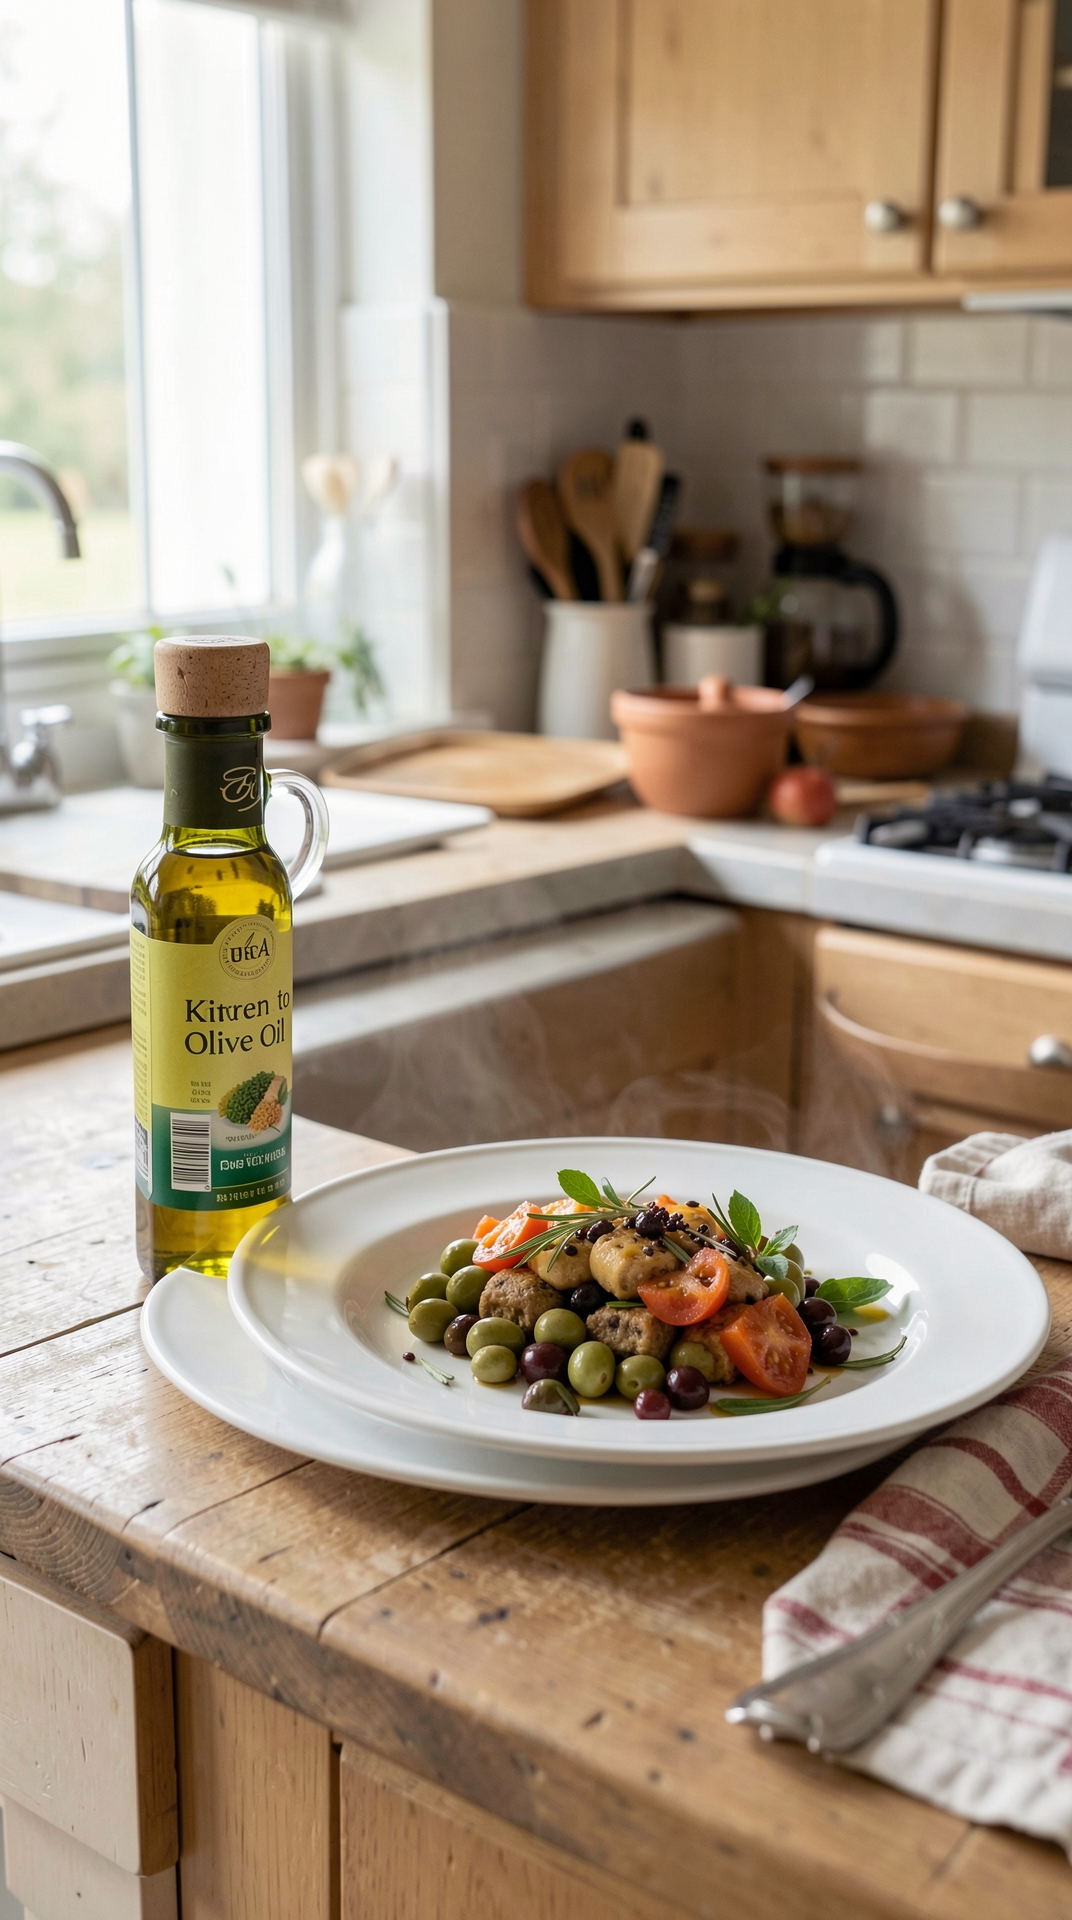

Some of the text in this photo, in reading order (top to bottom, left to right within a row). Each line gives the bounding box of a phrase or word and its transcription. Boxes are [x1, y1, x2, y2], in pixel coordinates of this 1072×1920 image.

[277, 990, 290, 1010] to
[184, 1017, 285, 1055] Olive Oil
